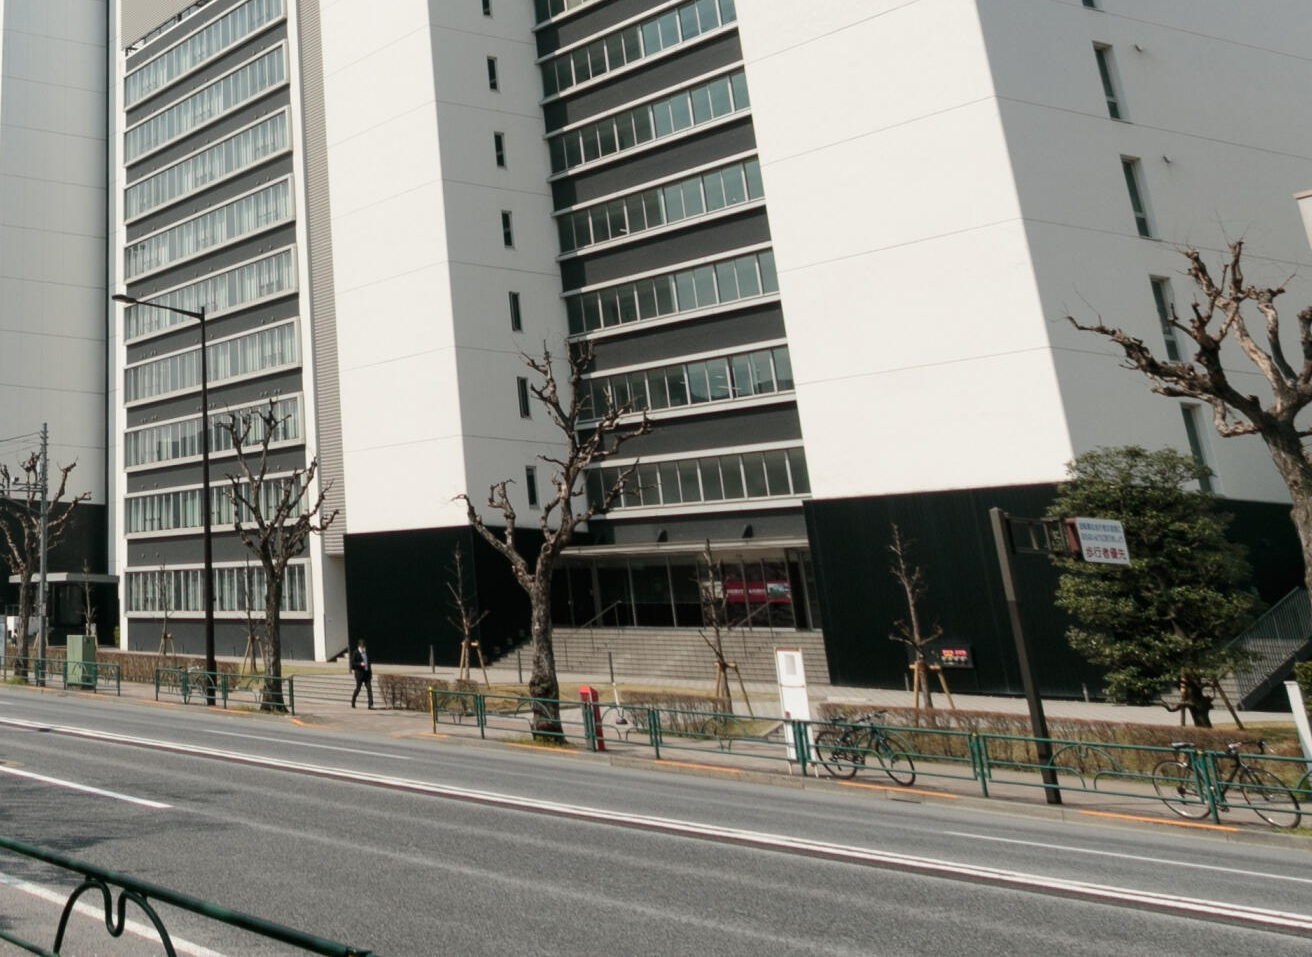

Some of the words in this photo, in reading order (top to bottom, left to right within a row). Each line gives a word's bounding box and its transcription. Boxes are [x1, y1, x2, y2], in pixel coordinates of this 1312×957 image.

[1086, 546, 1128, 560] 歩行者優先
